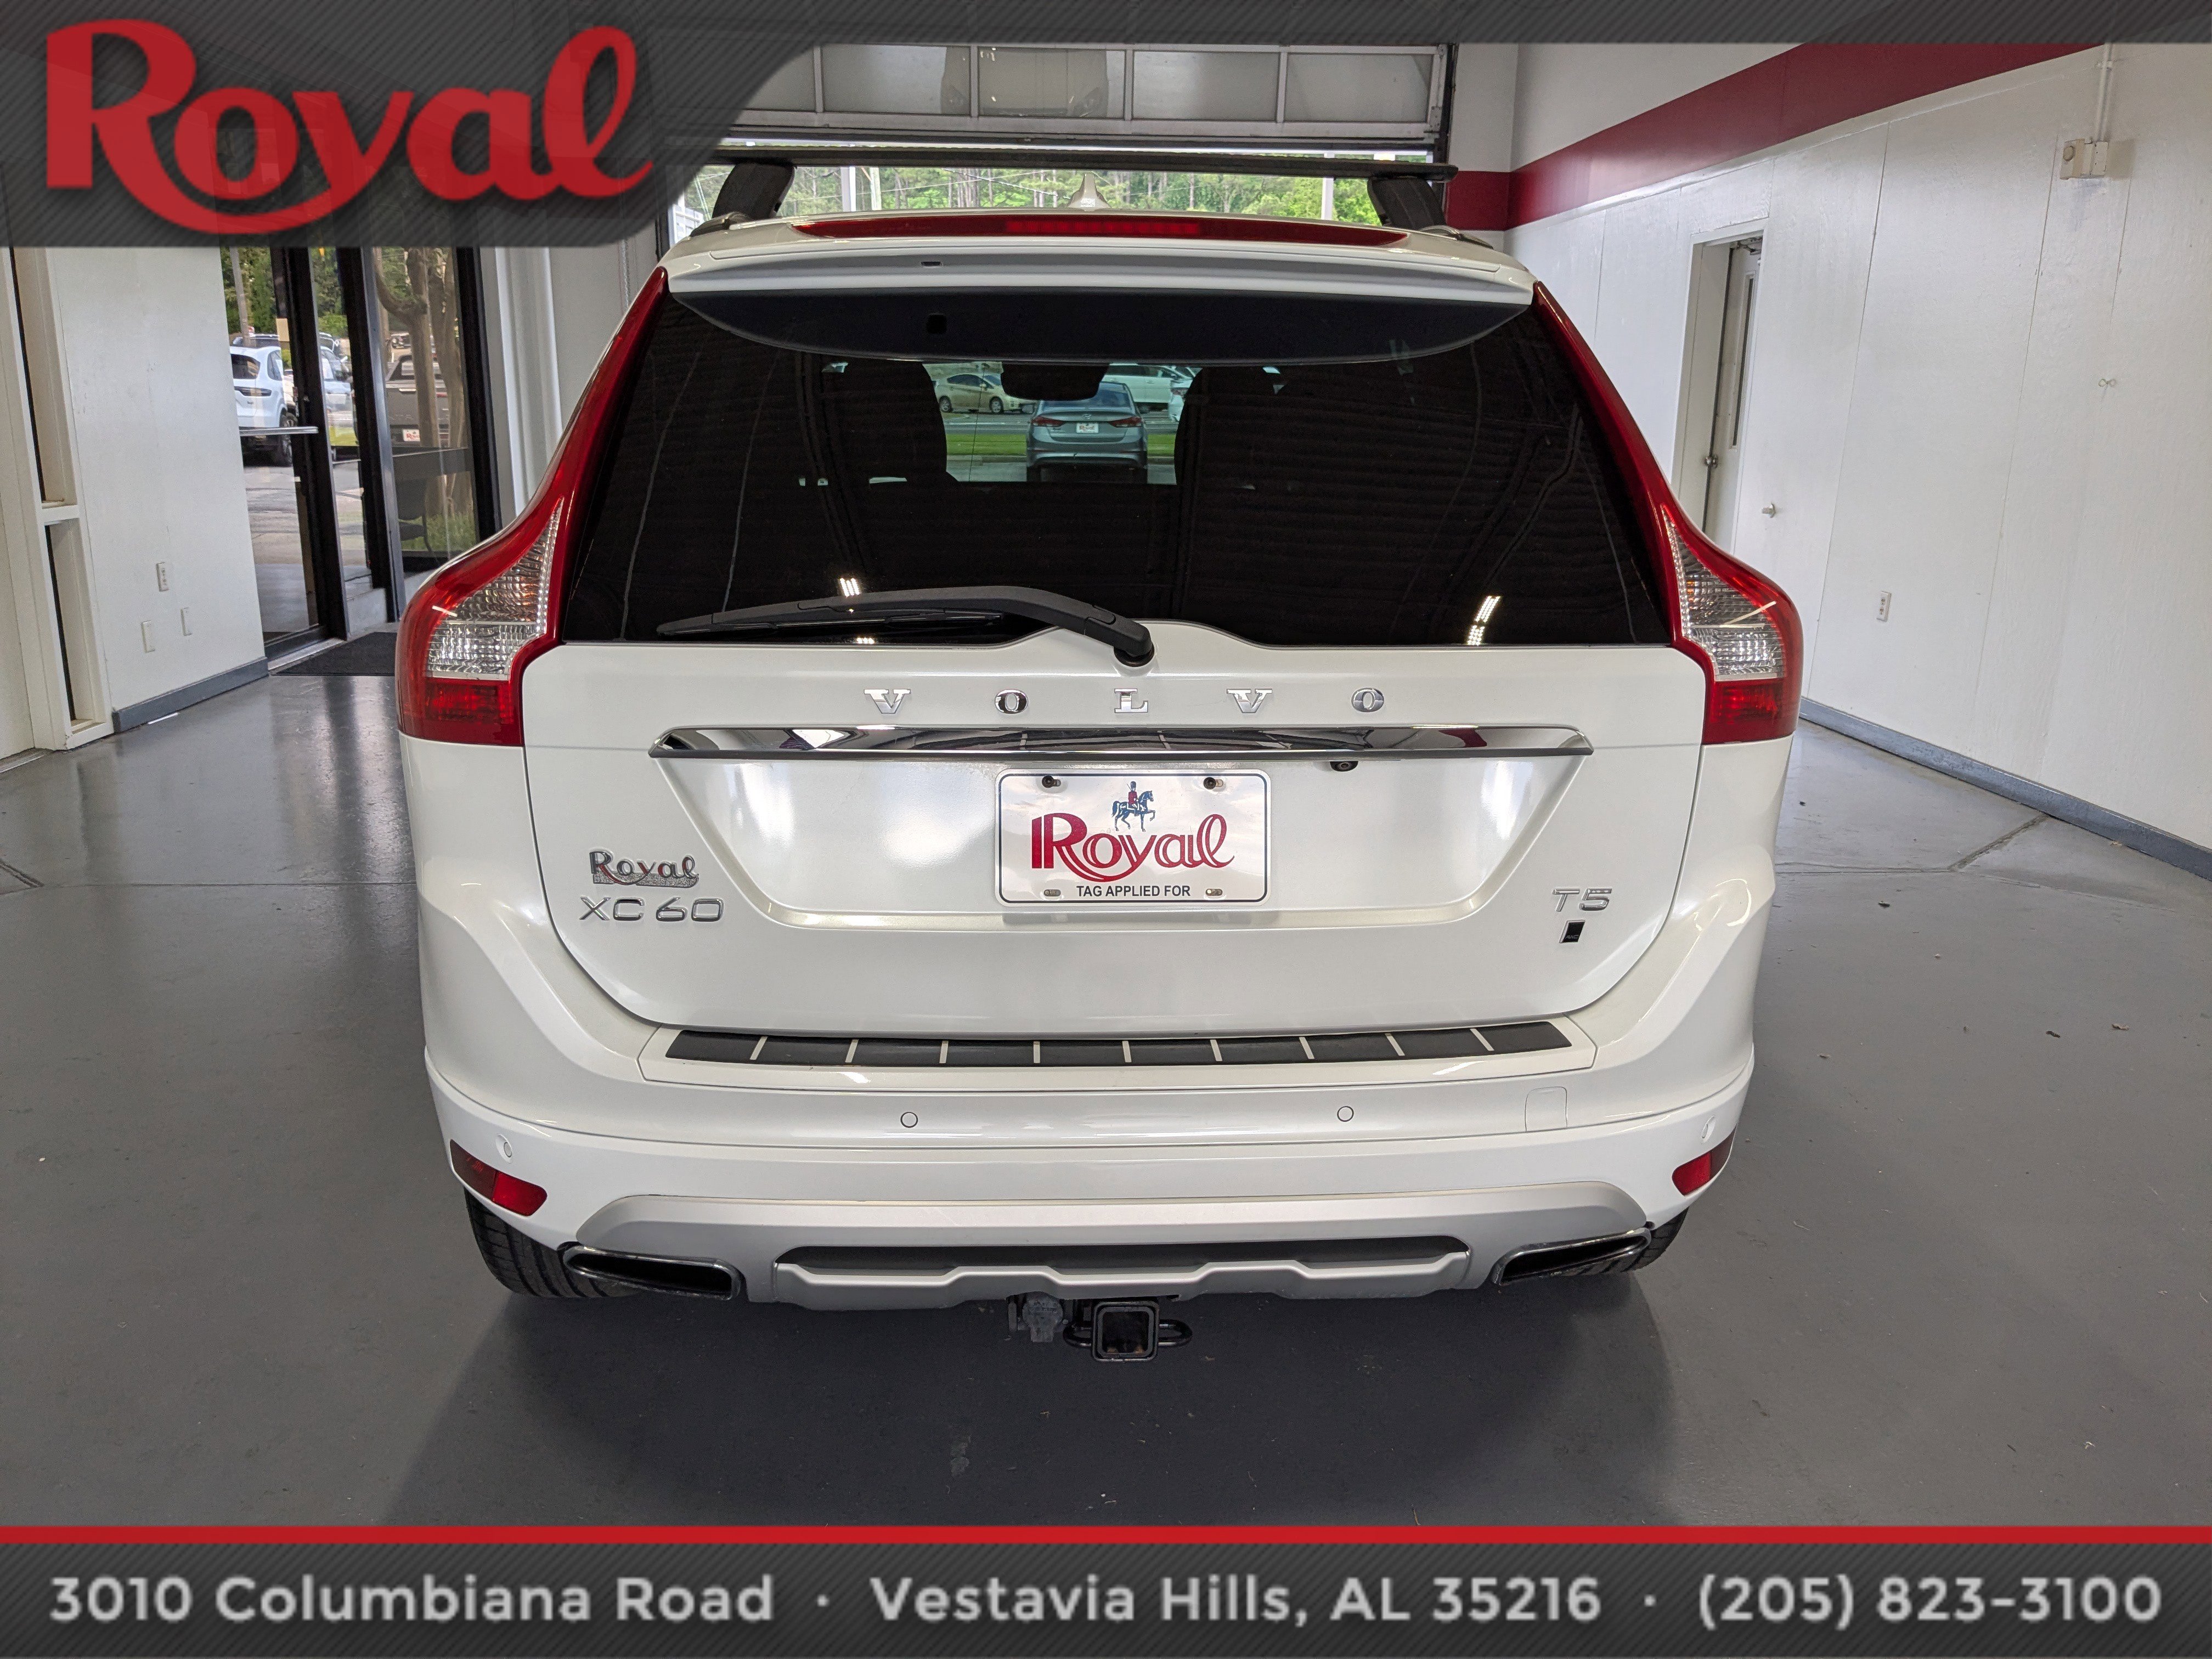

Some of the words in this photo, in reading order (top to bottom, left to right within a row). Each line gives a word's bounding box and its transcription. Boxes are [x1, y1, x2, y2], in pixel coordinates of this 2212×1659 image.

[864, 688, 1384, 713] VOLVO
[1031, 812, 1235, 882] Royal
[589, 851, 699, 885] Royal
[1076, 885, 1102, 897] TAG
[1105, 885, 1160, 897] APPLIED
[1164, 885, 1190, 897] FOR
[1552, 888, 1612, 912] T5
